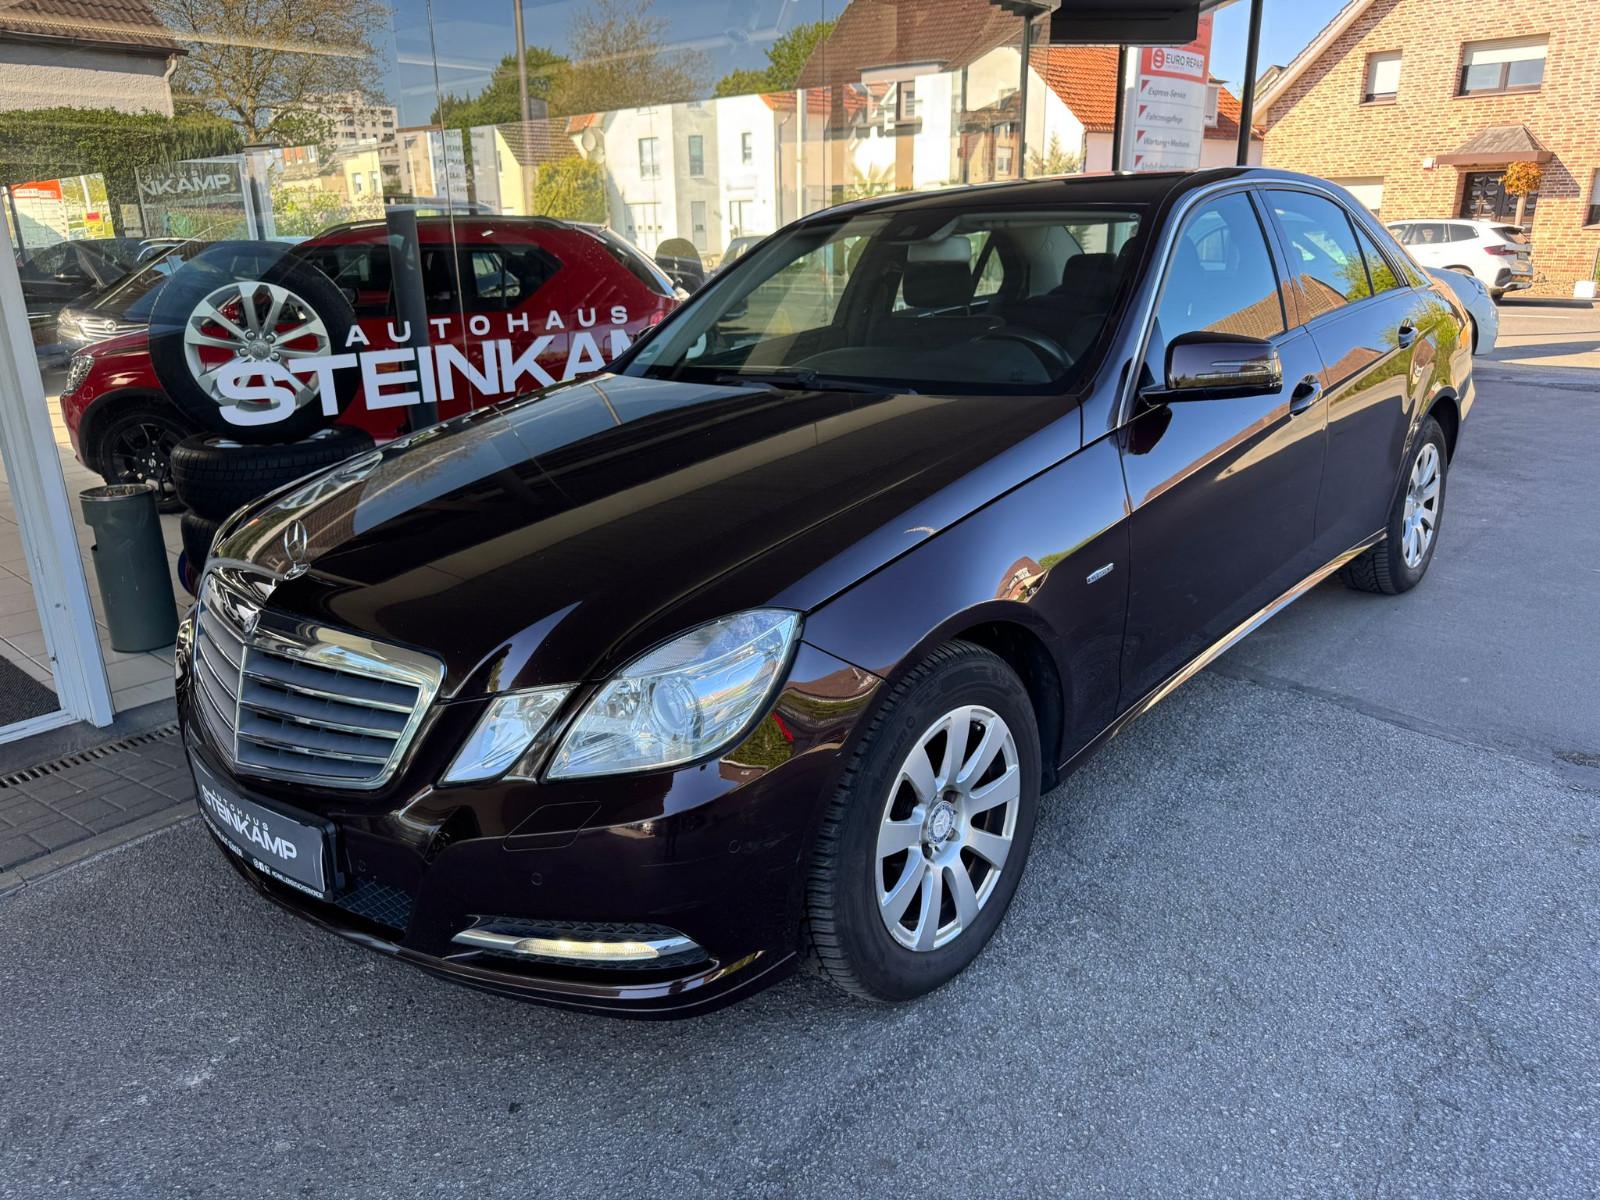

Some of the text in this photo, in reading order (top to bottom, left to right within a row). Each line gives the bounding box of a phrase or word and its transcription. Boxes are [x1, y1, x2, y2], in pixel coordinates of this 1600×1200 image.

[1166, 53, 1185, 66] EURO
[345, 305, 628, 347] AUTOHAUS
[201, 783, 298, 860] STEINKAMP
